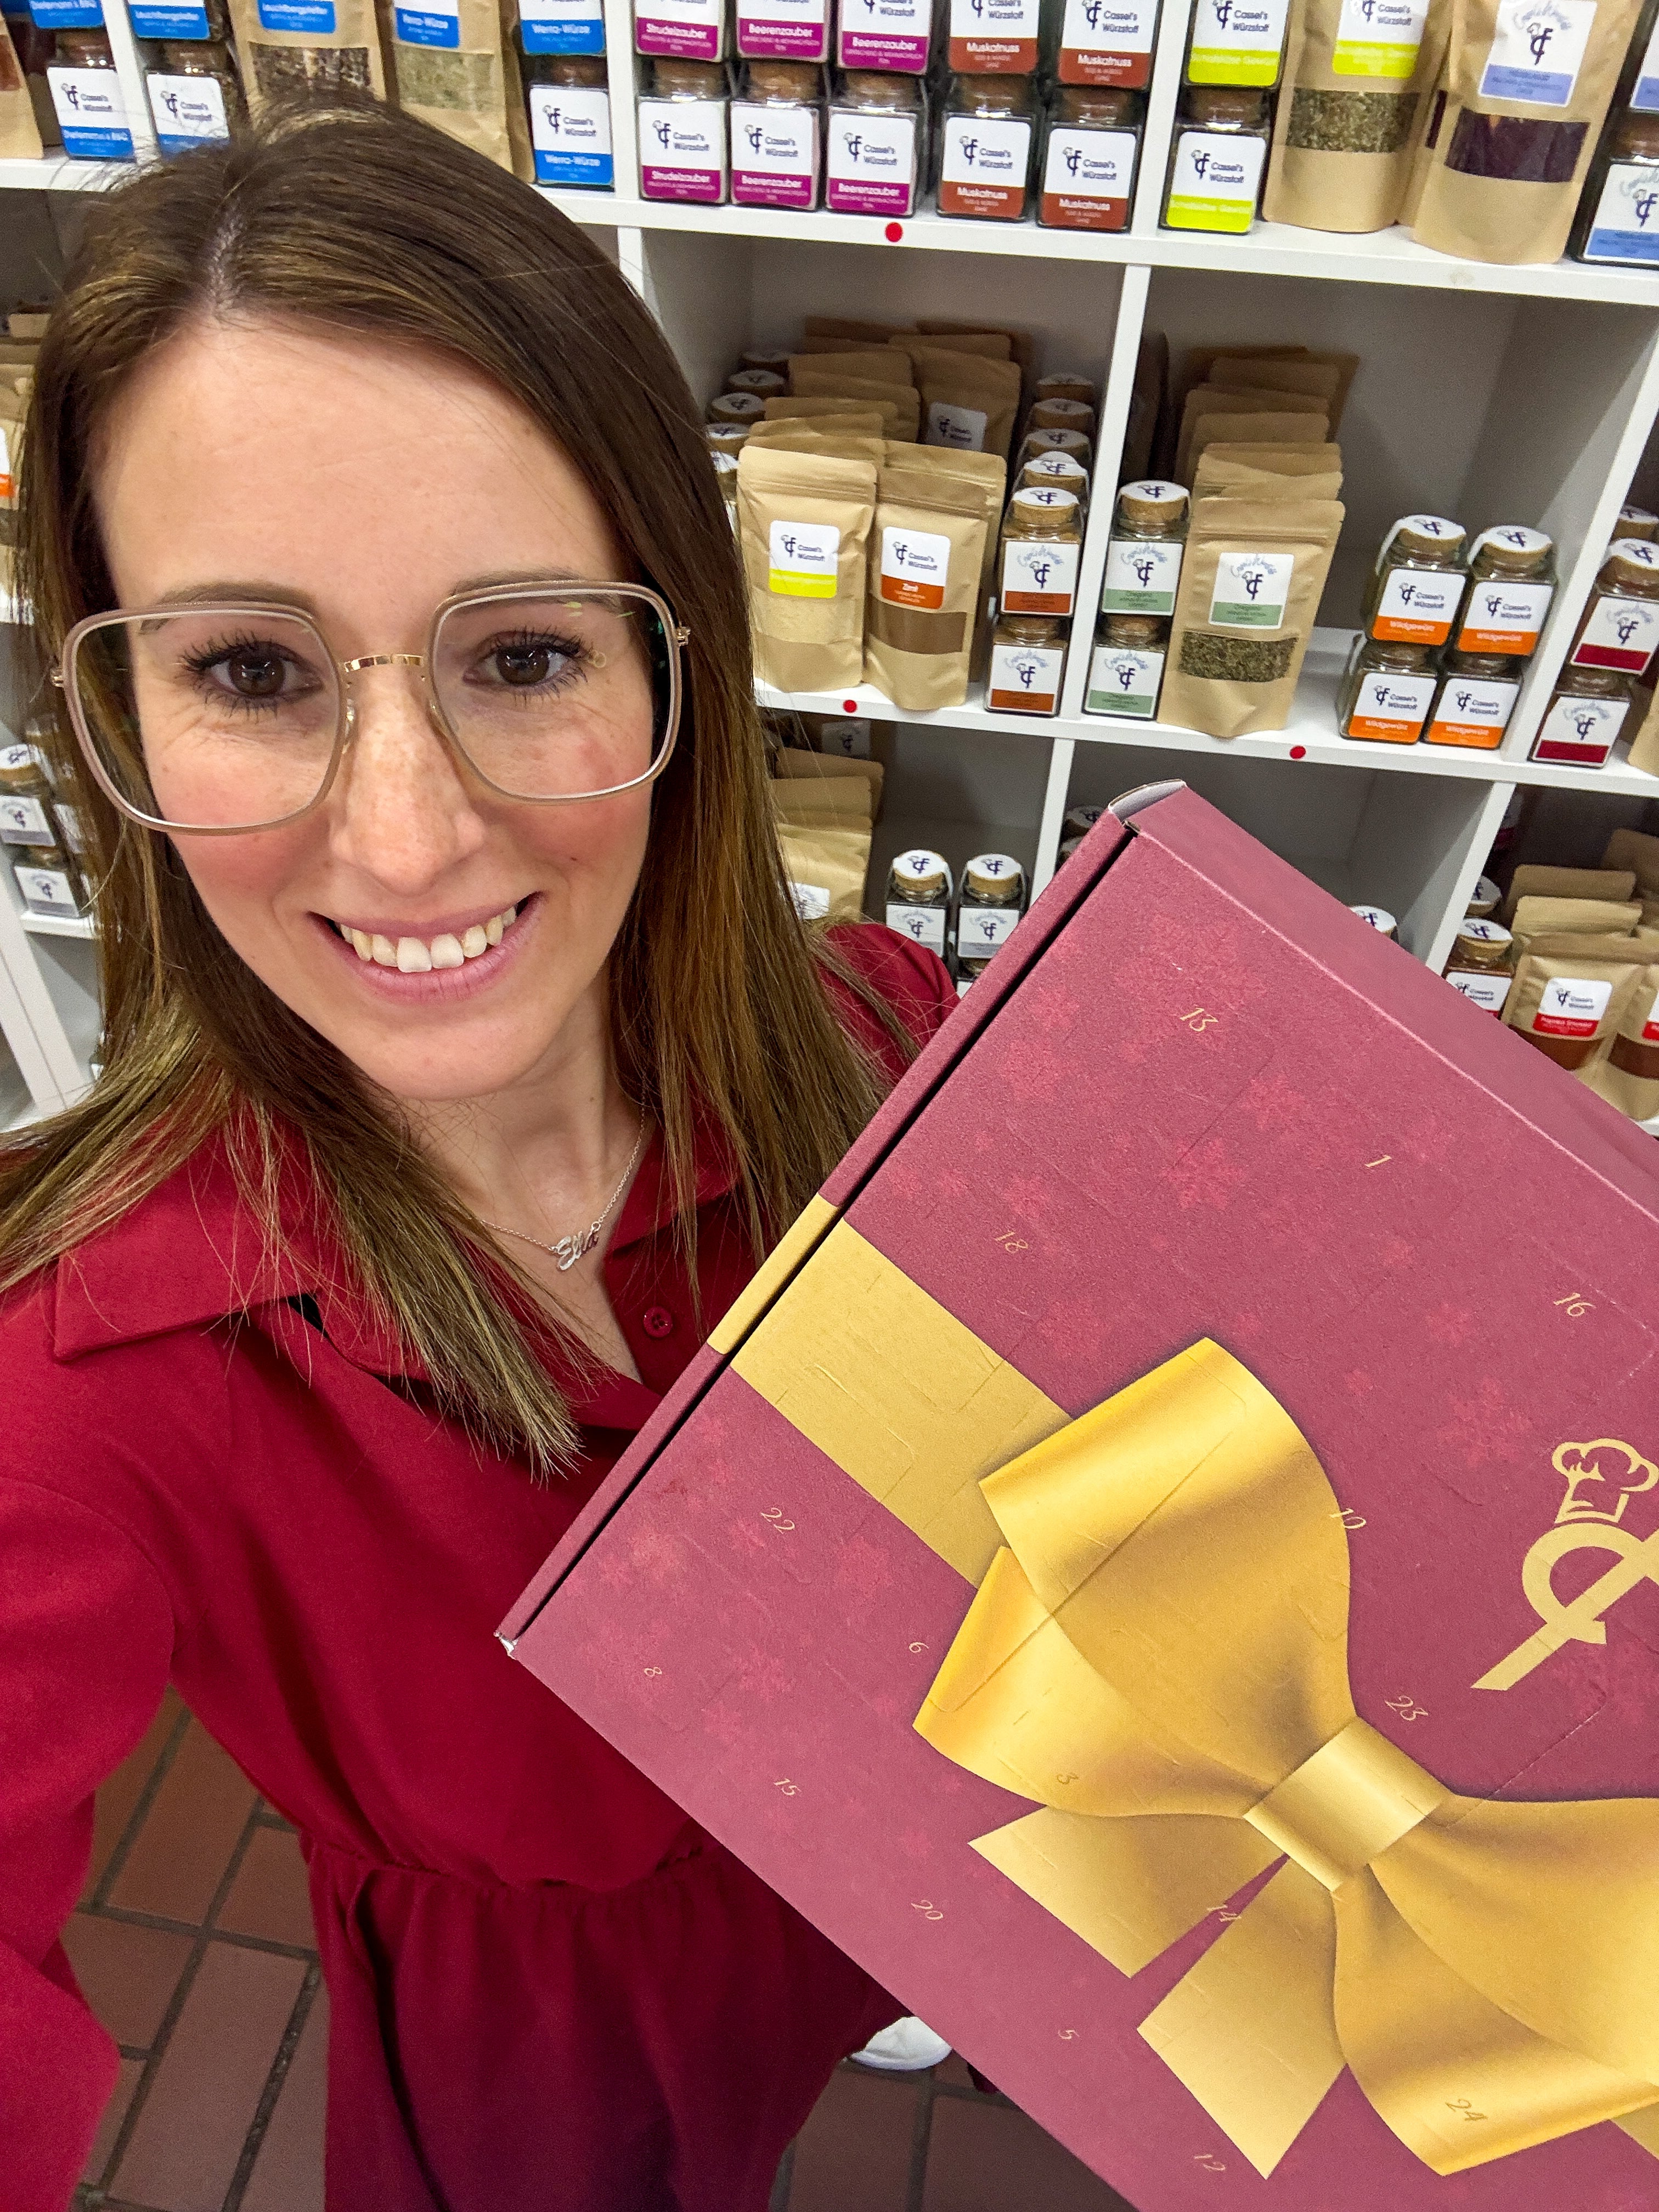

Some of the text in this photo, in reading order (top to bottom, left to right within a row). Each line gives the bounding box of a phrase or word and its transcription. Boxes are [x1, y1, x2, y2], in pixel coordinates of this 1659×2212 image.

[967, 42, 1020, 53] Muskatnuss
[1077, 54, 1132, 67] Muskatnuss
[1180, 1007, 1218, 1032] 13
[1365, 1155, 1392, 1168] 1
[994, 1231, 1029, 1254] 18
[1553, 1292, 1596, 1317] 16
[760, 1507, 795, 1534] 22
[1329, 1508, 1367, 1530] 10
[909, 1641, 929, 1653] 6
[644, 1667, 663, 1677] 8
[1385, 1695, 1429, 1722] 23
[774, 1778, 802, 1796] 15
[1057, 1773, 1079, 1785] 3
[911, 1899, 944, 1920] 20
[1206, 1904, 1242, 1922] 14
[1058, 2029, 1079, 2040] 5
[1445, 2098, 1488, 2121] 24
